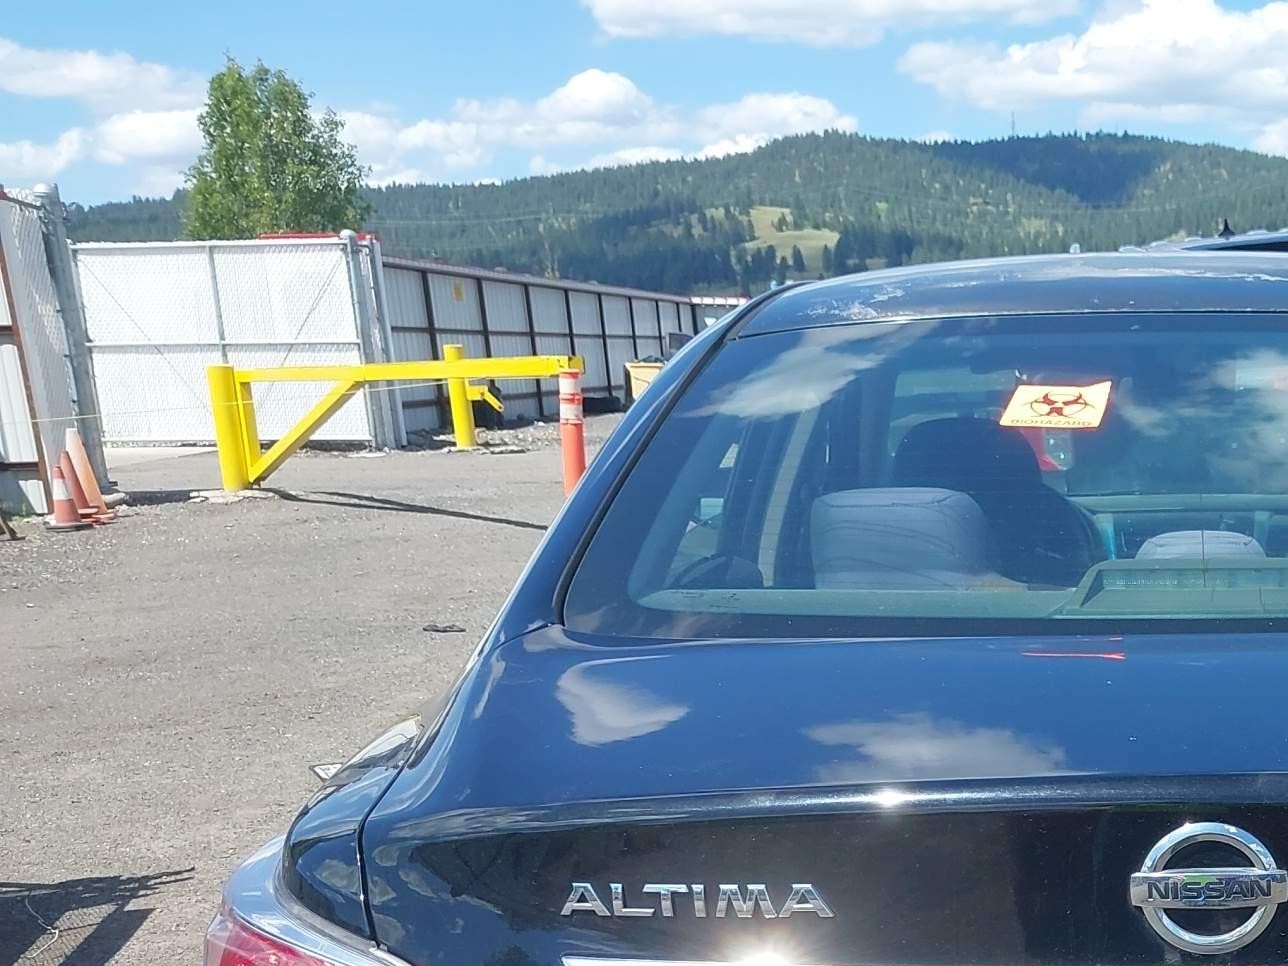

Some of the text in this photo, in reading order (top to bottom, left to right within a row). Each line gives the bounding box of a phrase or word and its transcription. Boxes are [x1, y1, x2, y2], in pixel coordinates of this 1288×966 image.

[1010, 418, 1092, 426] BIOHAZARD
[560, 882, 836, 918] ALTIMA
[1147, 879, 1272, 901] NISSAN
